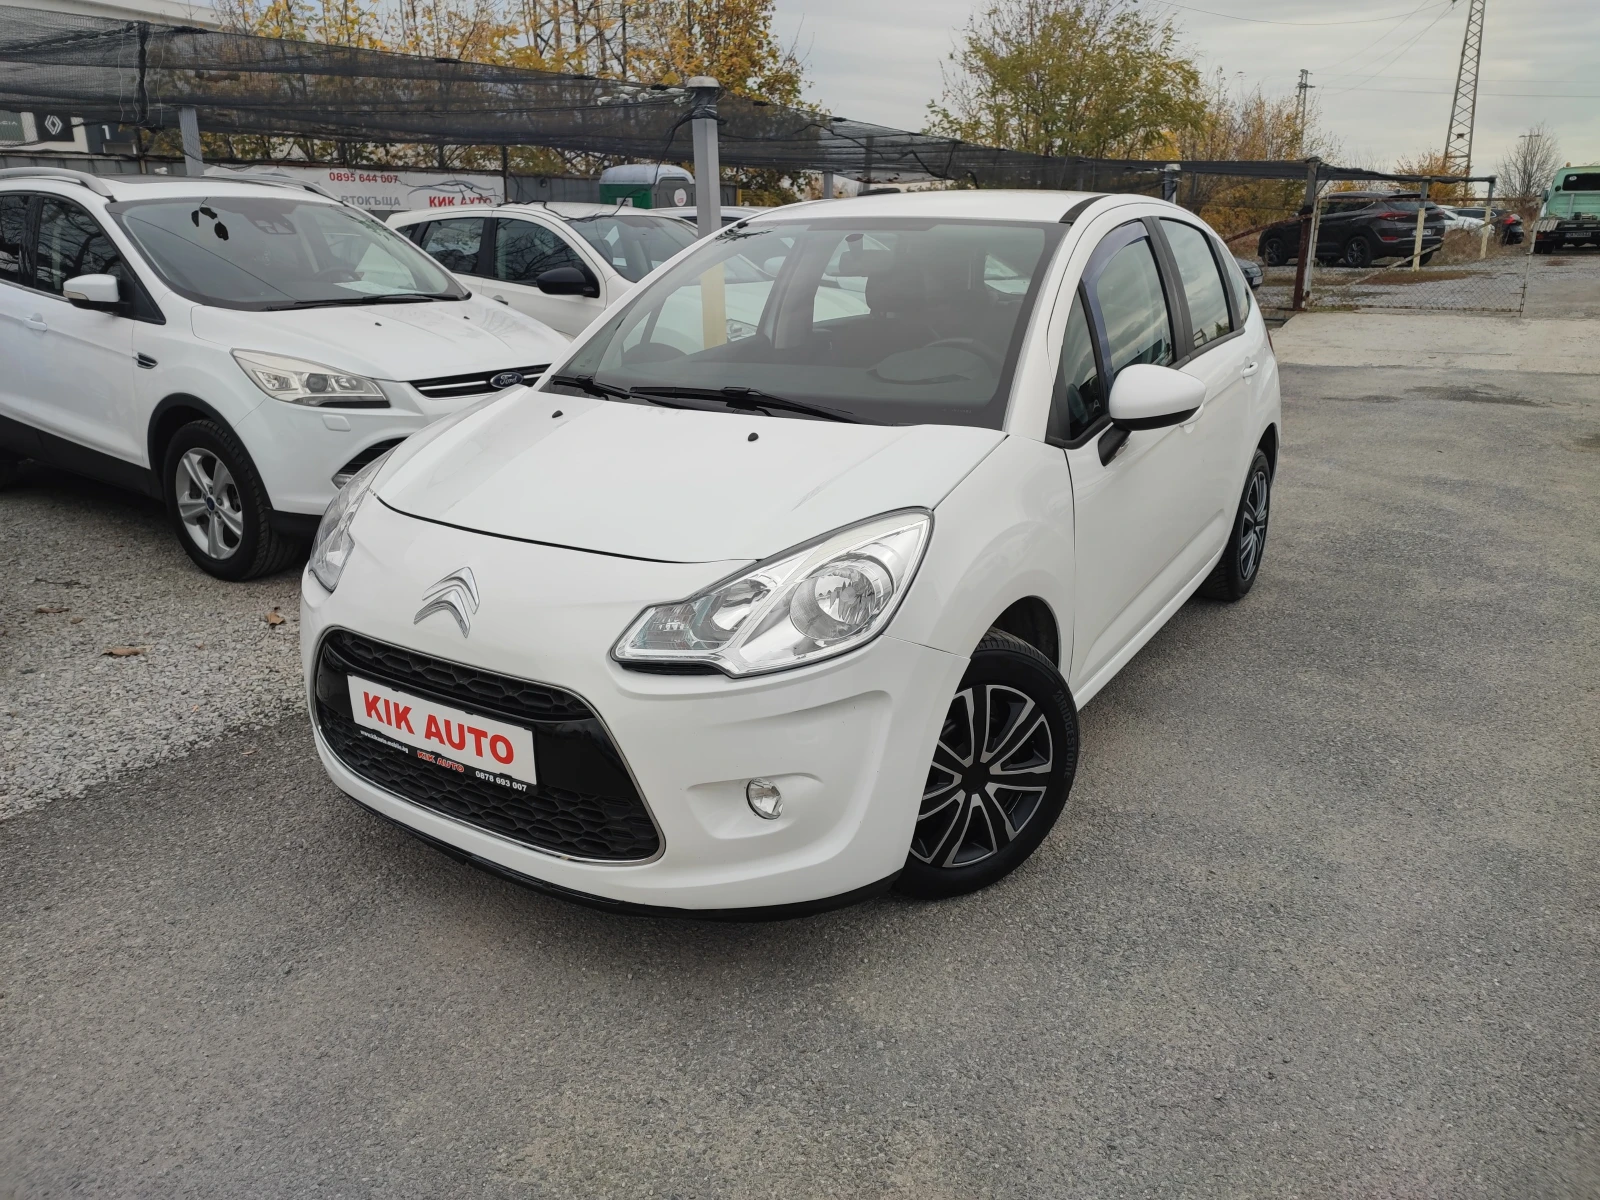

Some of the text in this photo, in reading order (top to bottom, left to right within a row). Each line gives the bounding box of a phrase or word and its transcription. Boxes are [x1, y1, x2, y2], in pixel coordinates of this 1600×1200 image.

[328, 172, 399, 184] 0895 644 007
[340, 195, 401, 207] ВТОКЪЩА
[428, 196, 455, 207] КИК
[500, 374, 518, 385] Ford
[363, 691, 515, 765] KIK AUTO
[417, 750, 465, 773] KIK AUTO
[475, 770, 528, 792] 0878 693 007
